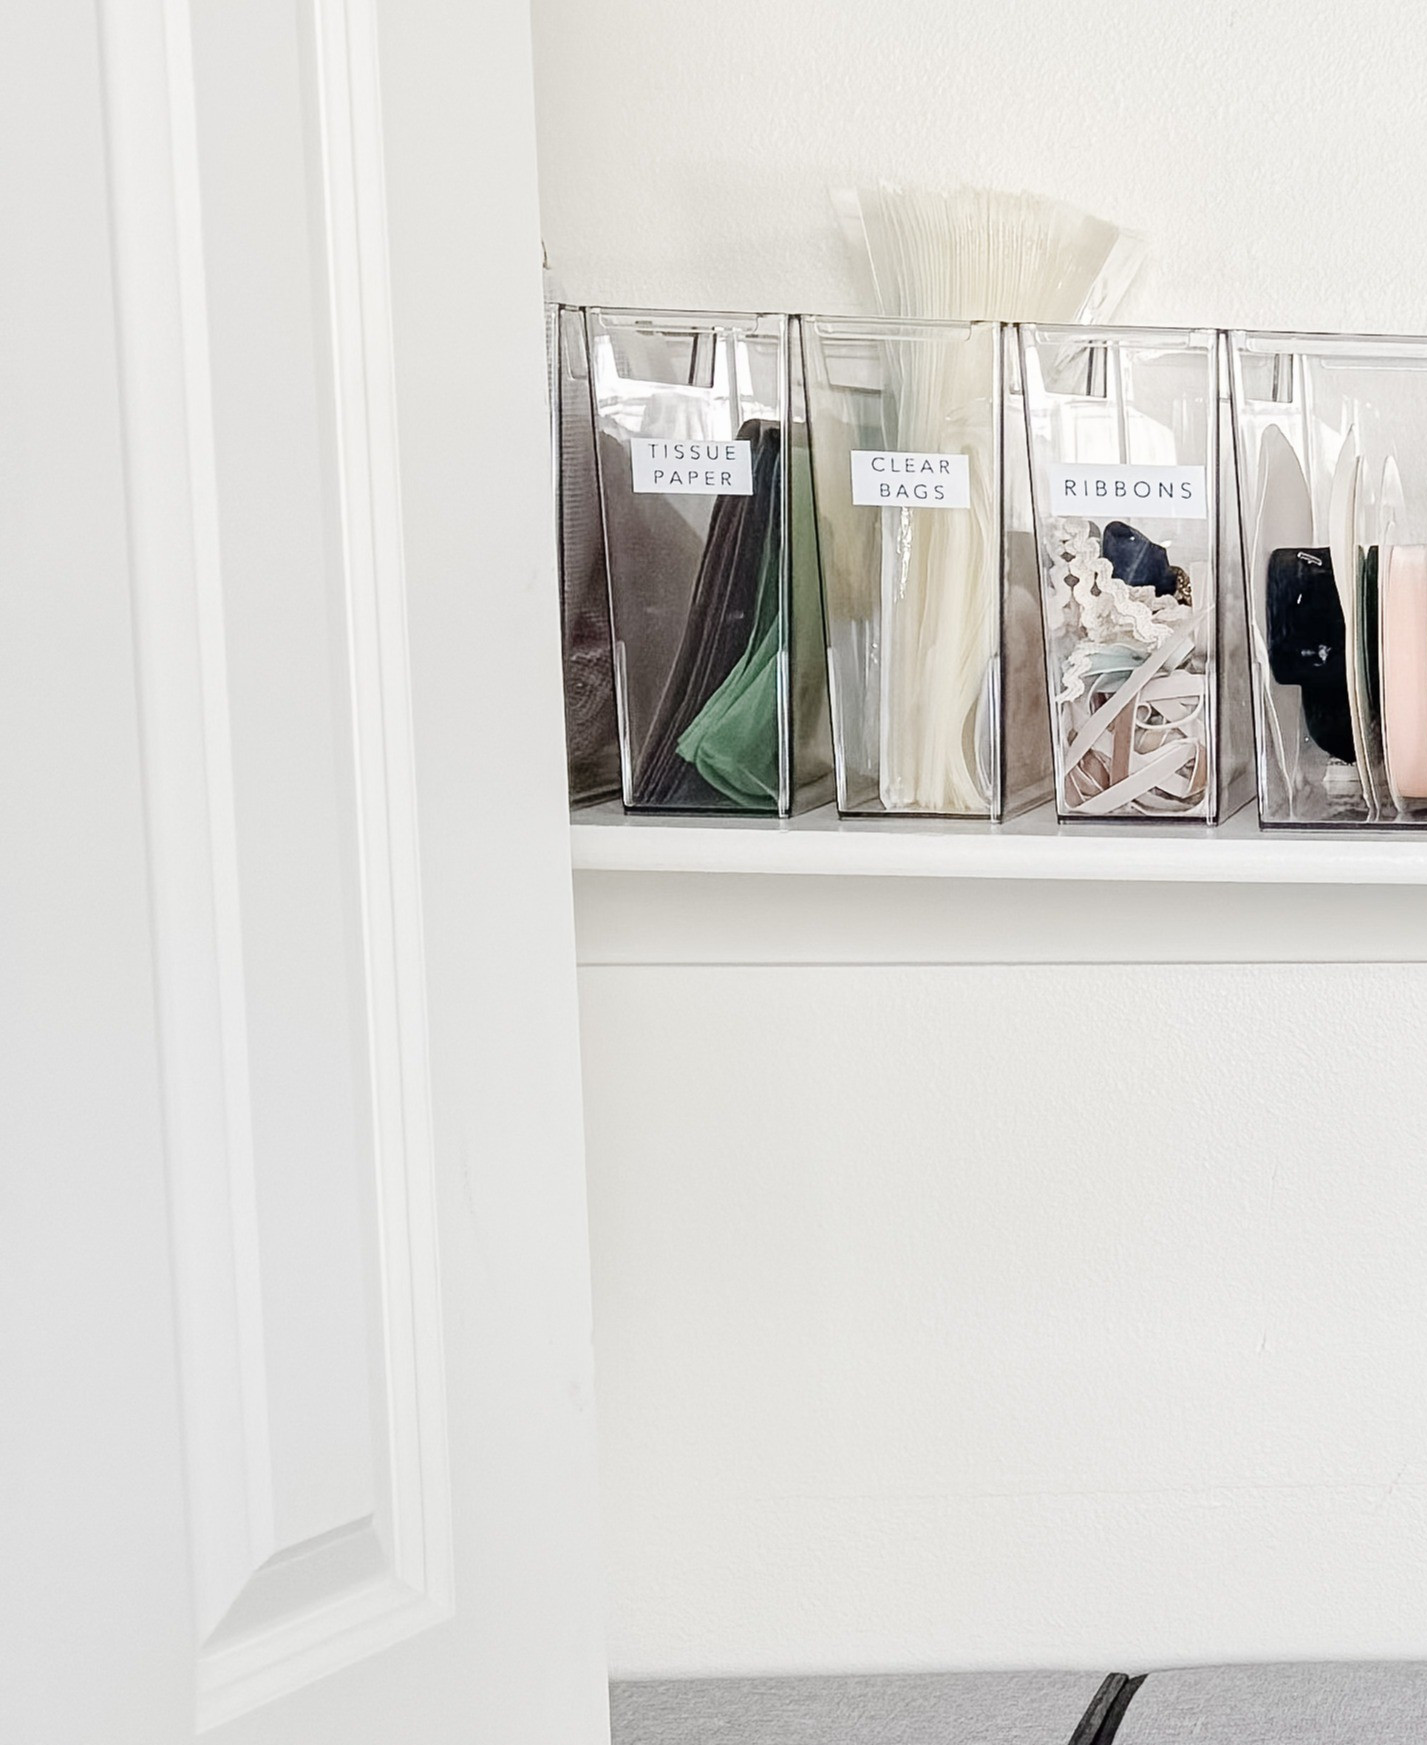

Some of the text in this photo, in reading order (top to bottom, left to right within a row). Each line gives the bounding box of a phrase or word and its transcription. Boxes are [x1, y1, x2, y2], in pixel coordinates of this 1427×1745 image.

[647, 443, 736, 461] TISSUE
[870, 456, 950, 475] CLEAR
[653, 469, 732, 487] PAPER
[879, 482, 945, 501] BAGS
[1064, 479, 1192, 500] RIBBONS
